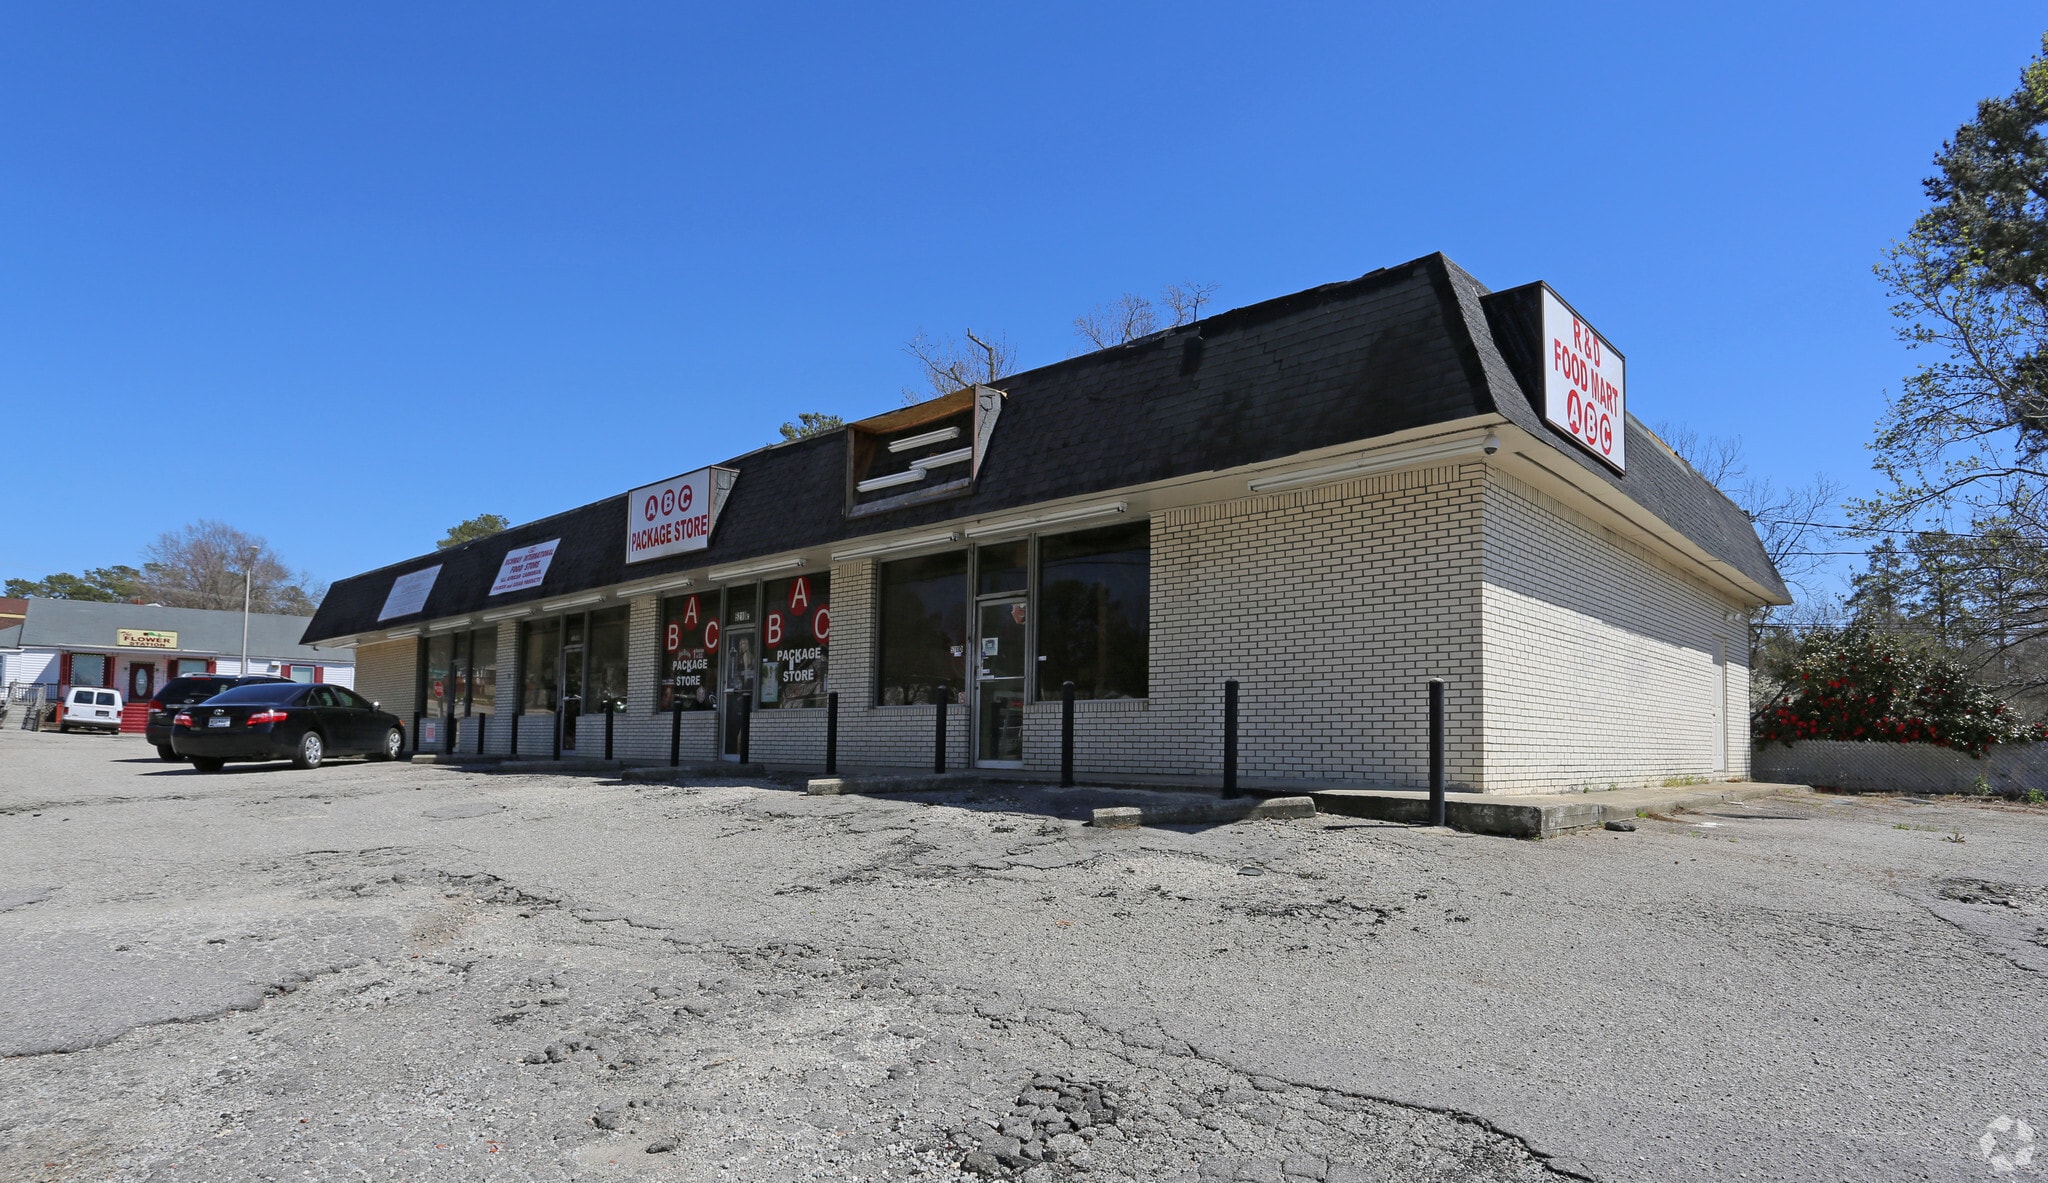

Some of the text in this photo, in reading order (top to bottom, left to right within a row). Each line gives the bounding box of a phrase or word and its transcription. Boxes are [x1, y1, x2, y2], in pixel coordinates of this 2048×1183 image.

[1554, 338, 1619, 418] FOOD MART
[631, 514, 708, 552] PACKAGE STORE
[510, 561, 541, 573] FOOD STORE
[124, 636, 171, 644] FLOWER
[776, 647, 822, 662] PACKAGE
[672, 658, 708, 671] PACKAGE
[676, 675, 701, 686] STORE
[782, 669, 815, 683] STORE
